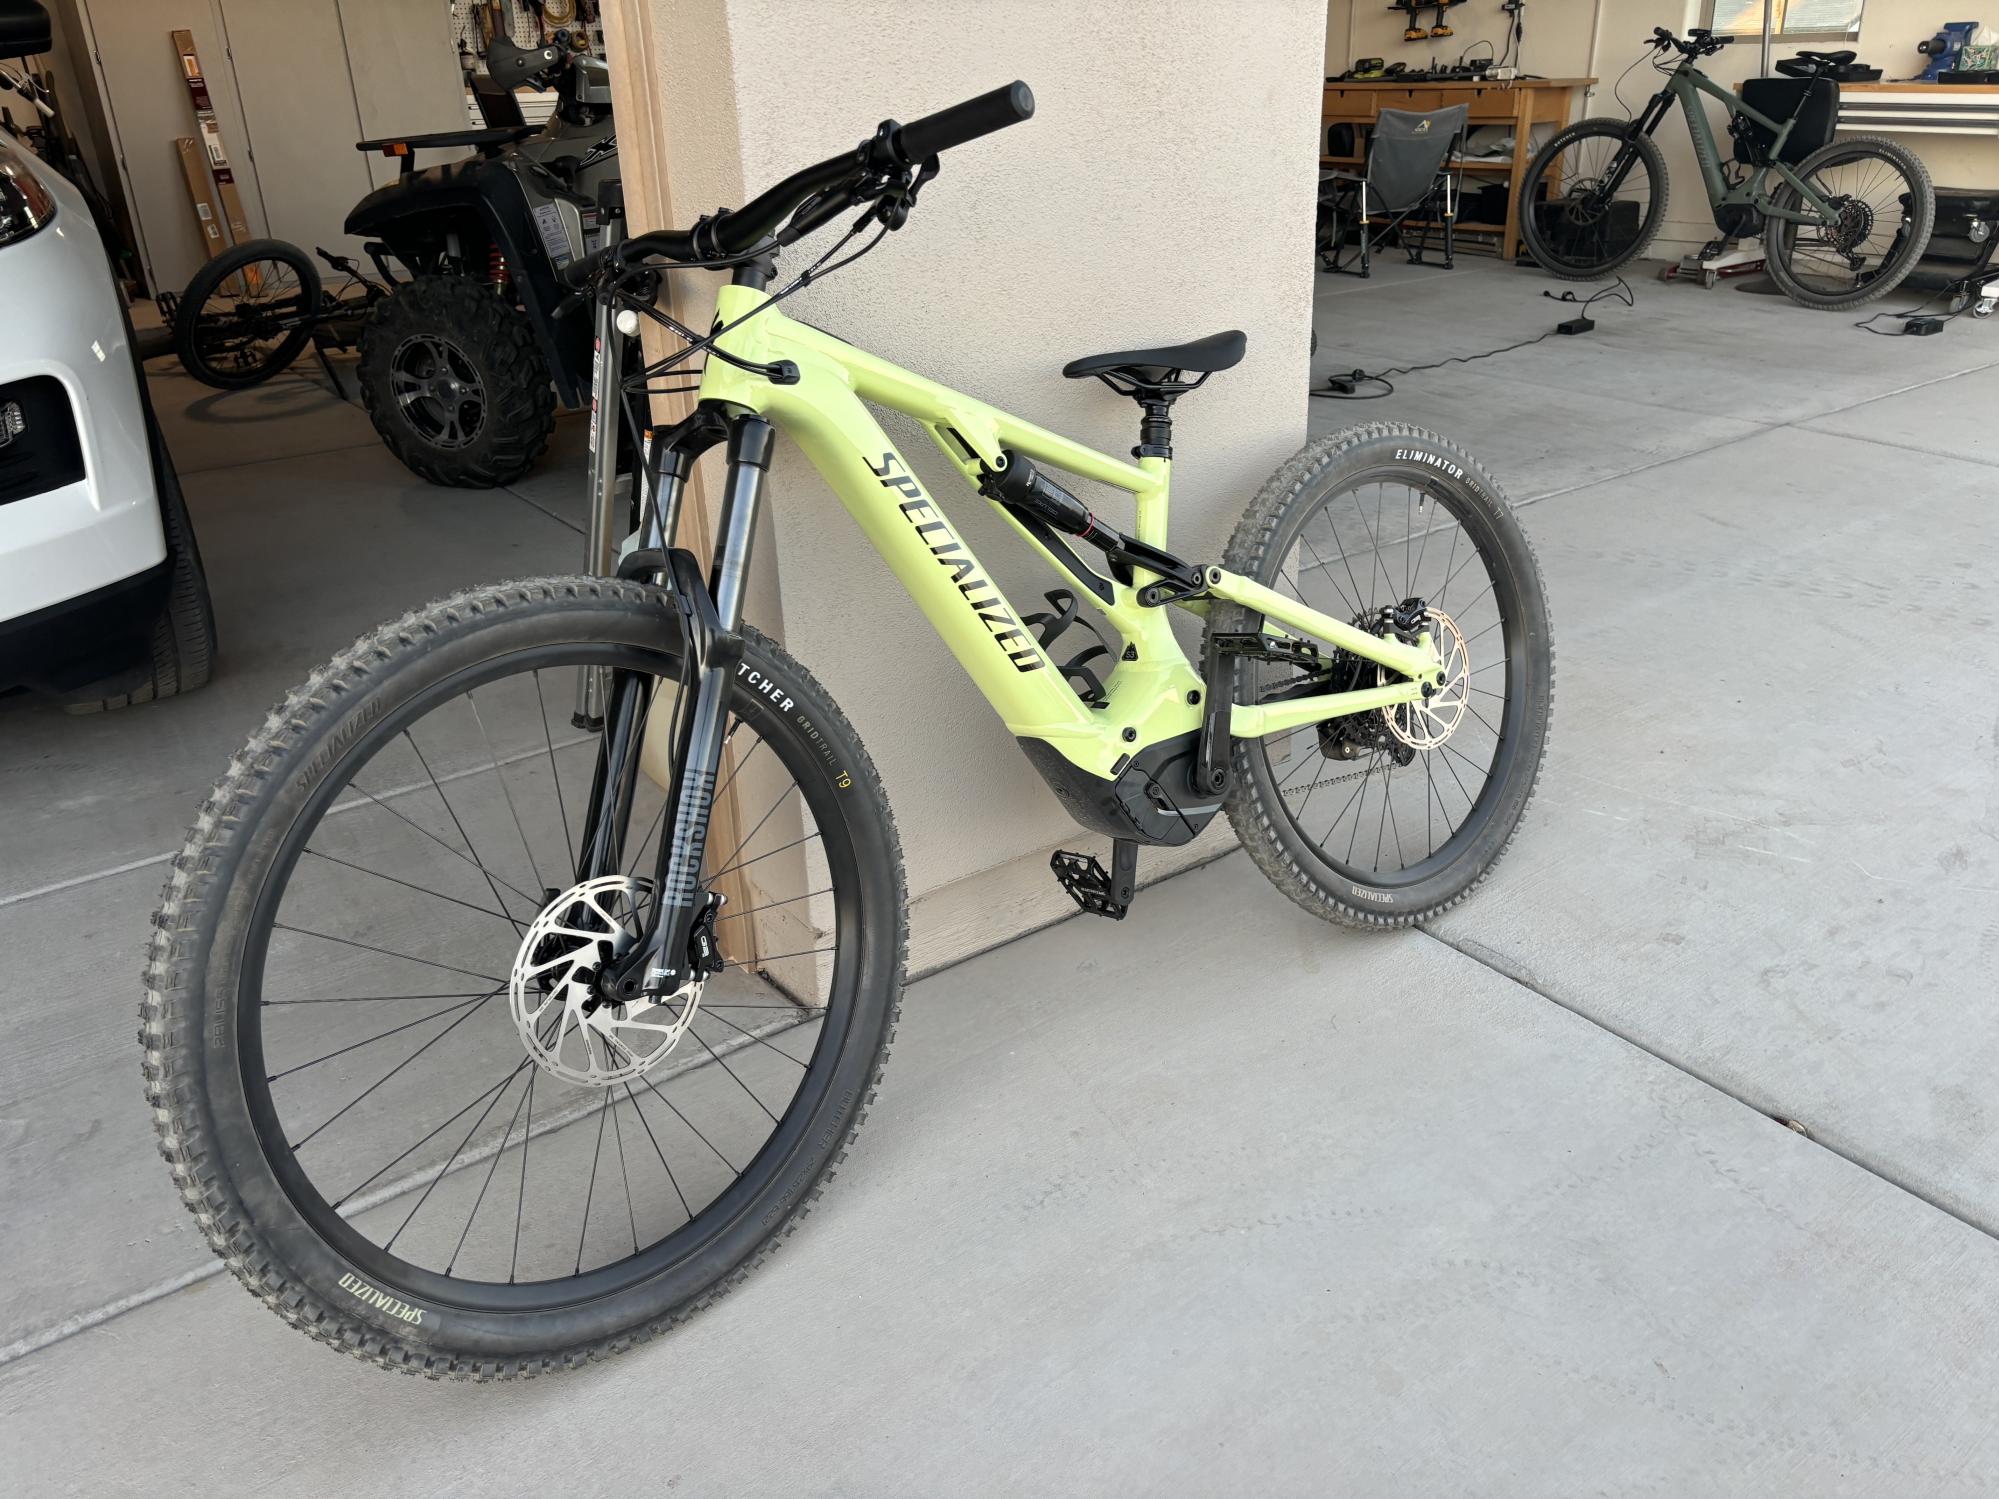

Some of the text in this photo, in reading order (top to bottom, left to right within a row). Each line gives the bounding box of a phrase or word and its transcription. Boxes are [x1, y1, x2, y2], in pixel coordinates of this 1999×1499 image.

[1395, 449, 1463, 479] ELIMINATOR
[862, 451, 1046, 673] SPECIALIZED
[737, 662, 851, 788] TCHER GRIDTRAIL T9
[1351, 885, 1394, 903] SPECIALIZED
[338, 1272, 427, 1325] SPECIALIZED
